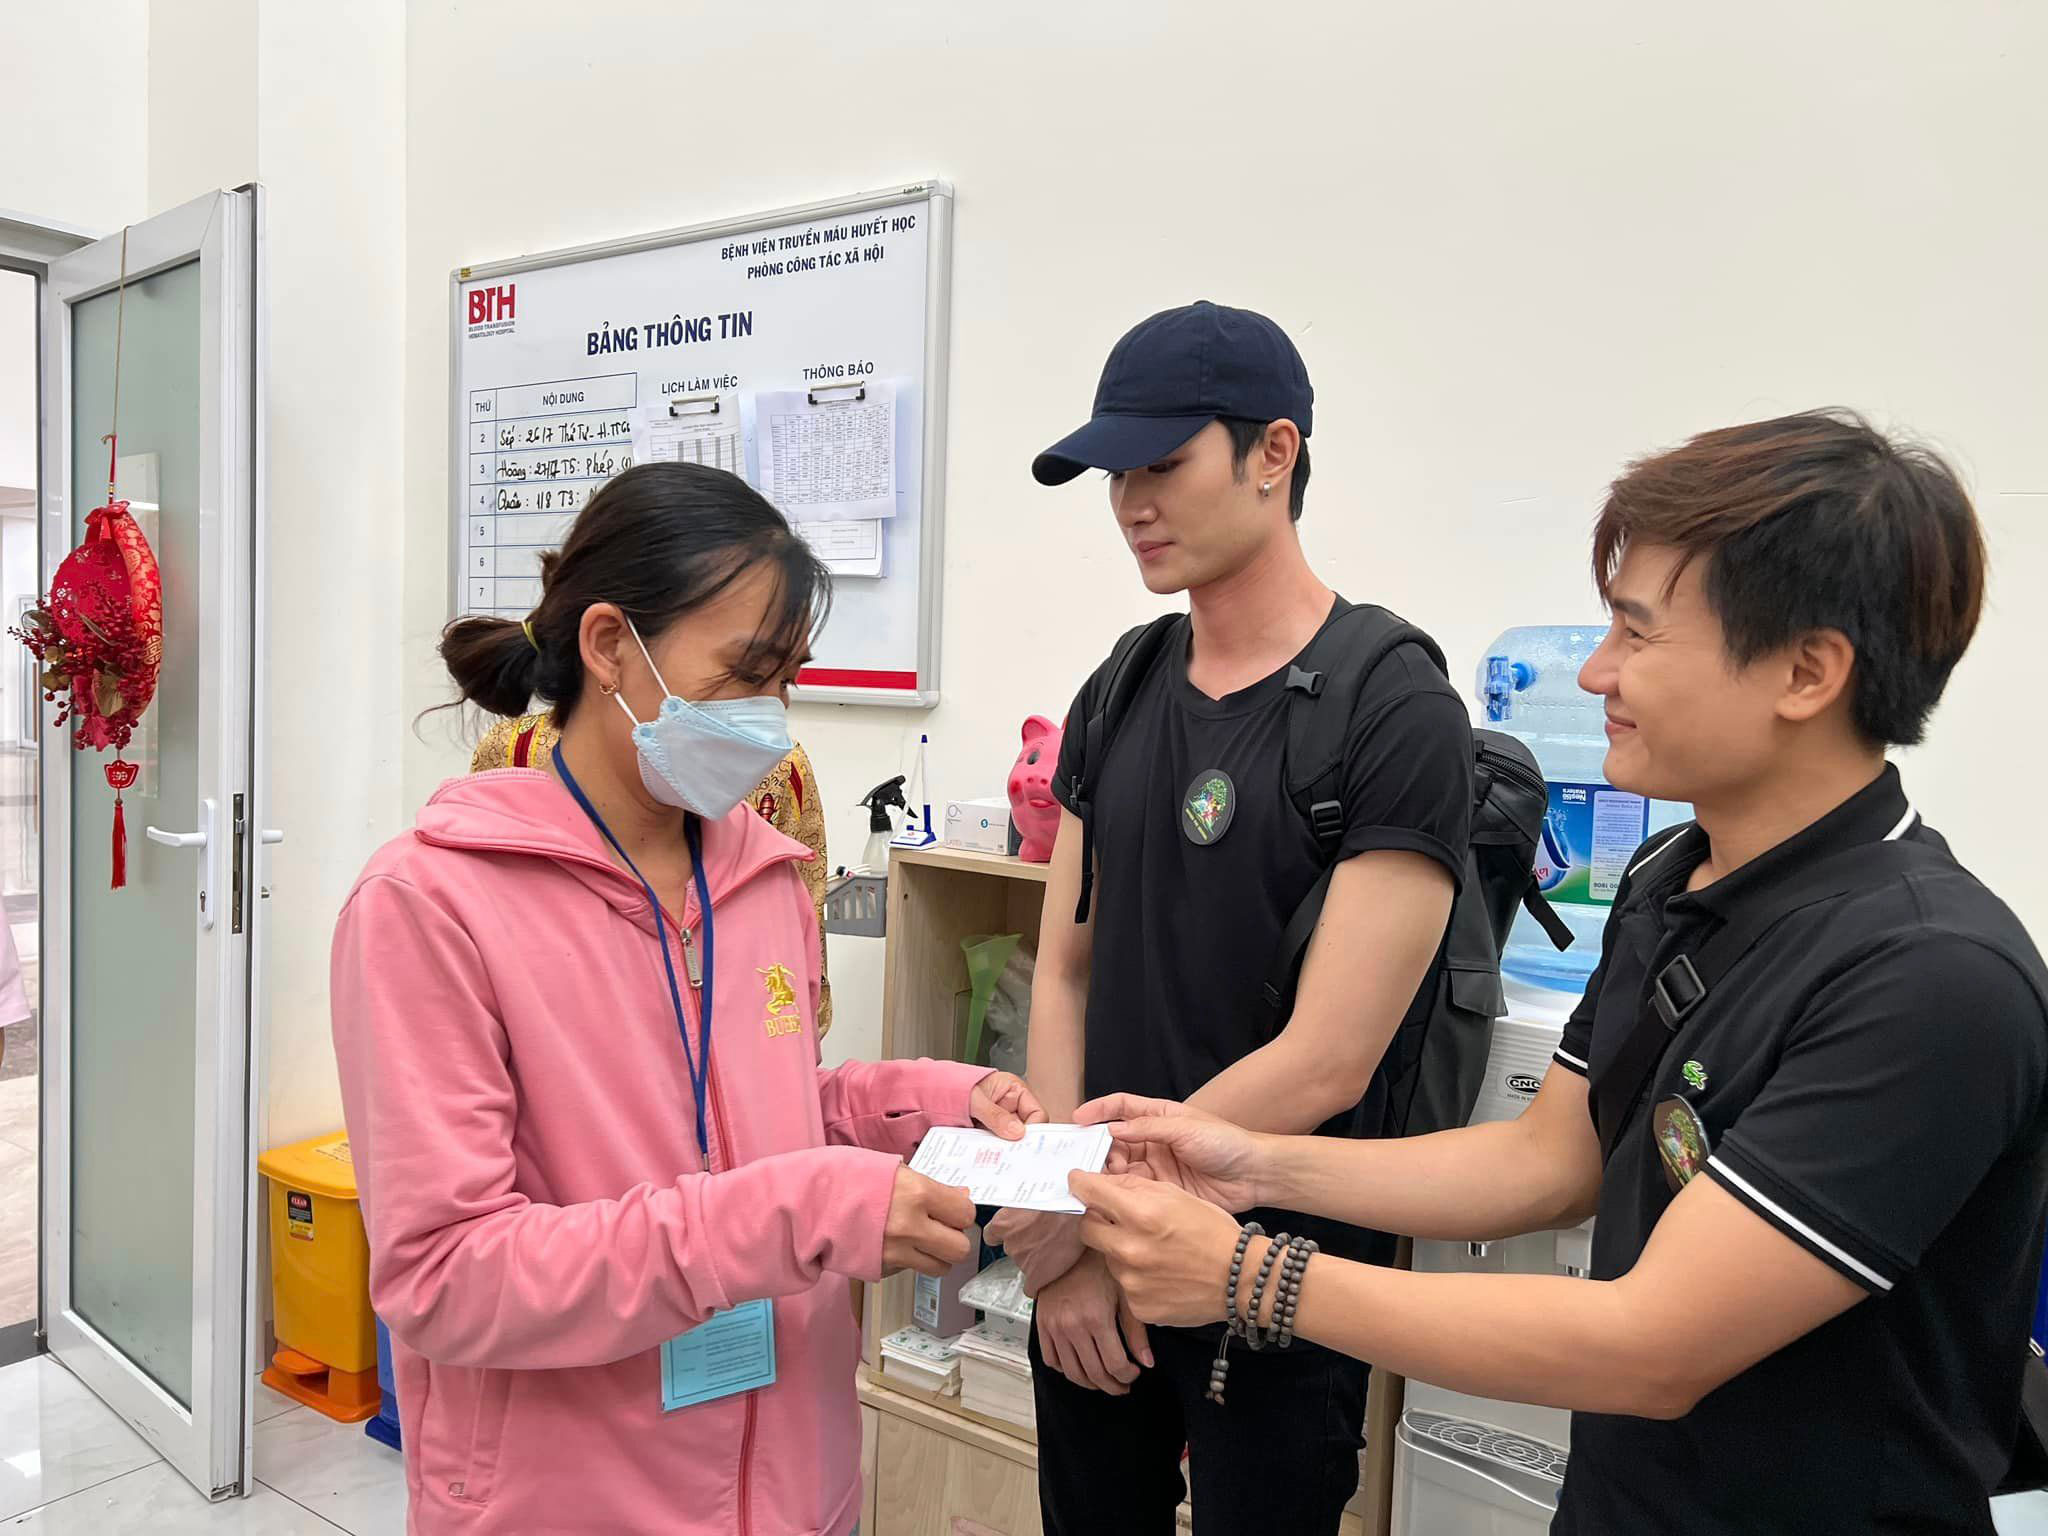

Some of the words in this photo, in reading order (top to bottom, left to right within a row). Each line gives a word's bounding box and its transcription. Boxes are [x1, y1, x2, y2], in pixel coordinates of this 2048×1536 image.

[721, 243, 749, 262] BỆNH
[752, 238, 776, 256] VIỆN
[778, 228, 821, 252] TRUYỀN
[824, 224, 848, 243] MÁU
[851, 216, 888, 238] HUYẾT
[892, 215, 916, 233] HỌC
[747, 260, 784, 280] PHÒNG
[786, 256, 816, 274] CÔNG
[818, 251, 842, 268] TÁC
[844, 248, 860, 264] XÃ
[864, 244, 884, 263] HỘI
[468, 283, 516, 324] BTH
[587, 321, 638, 356] BẢNG
[644, 314, 712, 348] THÔNG
[718, 311, 753, 339] TIN
[803, 364, 844, 381] THÔNG
[848, 360, 874, 376] BÁO
[662, 381, 685, 396] LỊCH
[688, 376, 710, 392] LÀM
[713, 374, 738, 390] VIỆC
[543, 392, 558, 407] NỘI
[560, 391, 584, 404] DUNG
[476, 401, 492, 413] THỨ
[480, 434, 486, 443] 2
[480, 464, 485, 474] 3
[480, 496, 484, 504] 4
[480, 526, 485, 536] 5
[480, 557, 485, 567] 6
[480, 587, 485, 597] 7
[1510, 1079, 1541, 1089] CNC
